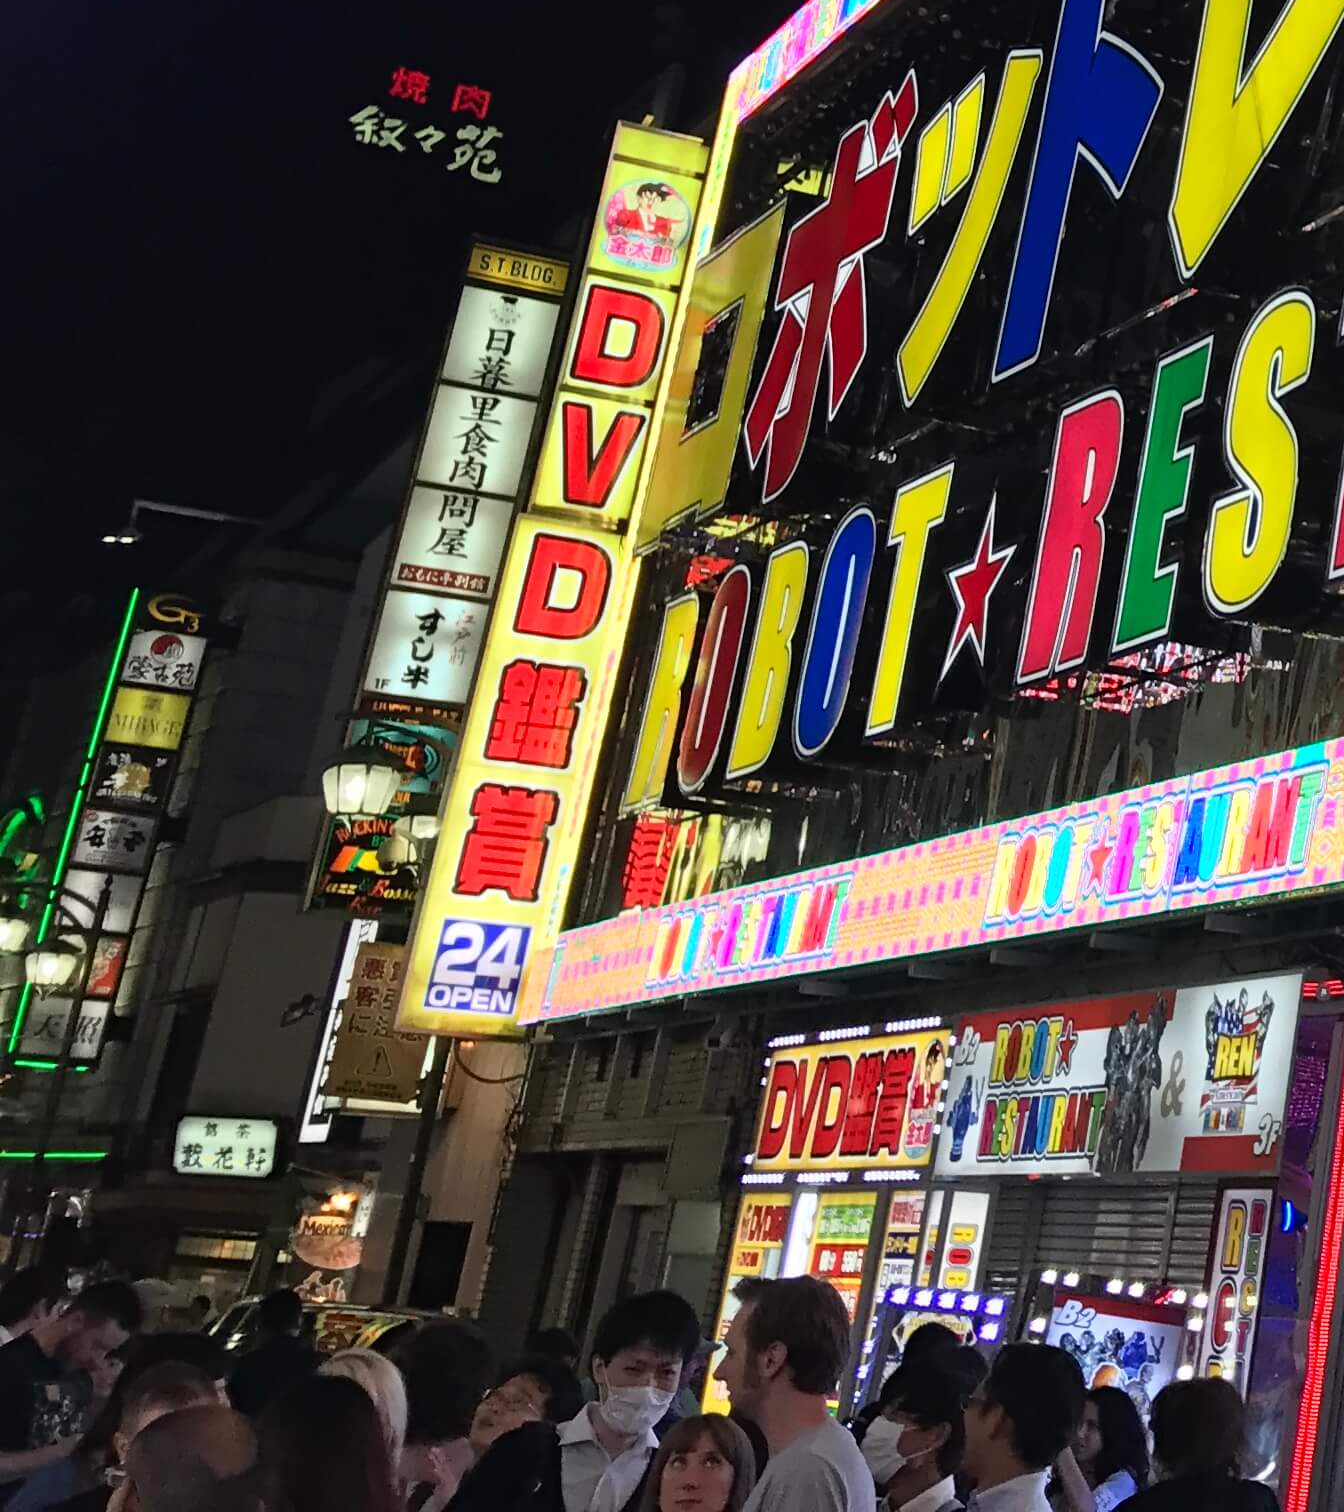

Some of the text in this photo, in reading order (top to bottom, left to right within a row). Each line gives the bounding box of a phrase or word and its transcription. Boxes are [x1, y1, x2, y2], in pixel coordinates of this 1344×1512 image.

[390, 66, 491, 120] 焼肉
[349, 104, 504, 184] 叙々苑
[479, 252, 558, 287] S.T.BLDG.
[426, 327, 516, 560] 日暮里食肉問屋
[622, 463, 954, 813] ROBOT
[984, 763, 1327, 928] ROBOT RESTAURANT
[433, 921, 522, 988] 24
[428, 984, 514, 1013] OPEN
[954, 1025, 981, 1067] B2
[988, 1016, 1062, 1087] ROBOT
[1213, 1033, 1258, 1082] REN
[756, 1046, 916, 1160] DVD鑑賞
[976, 1089, 1108, 1163] RESTAURANT
[1055, 1299, 1097, 1329] B2
